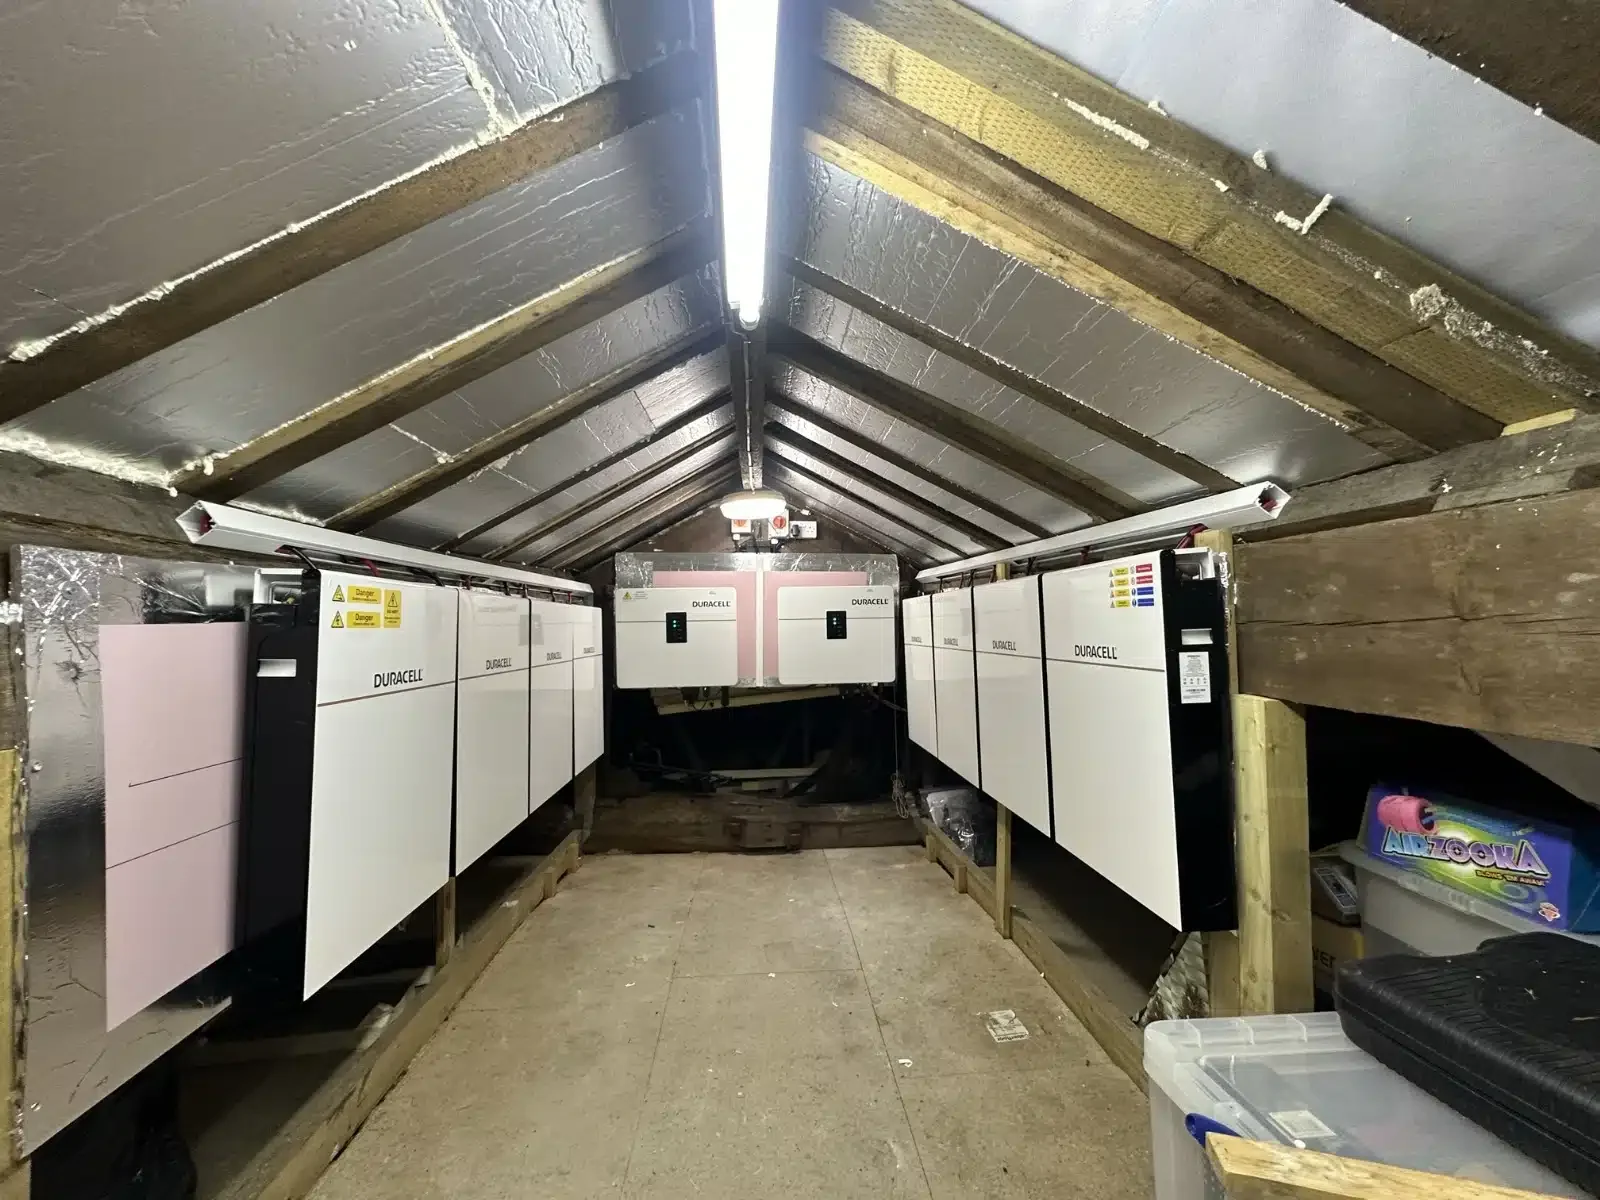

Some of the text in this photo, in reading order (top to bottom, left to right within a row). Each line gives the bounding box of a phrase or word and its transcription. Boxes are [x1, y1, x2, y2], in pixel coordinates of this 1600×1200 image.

[356, 589, 375, 598] Danger
[692, 600, 732, 608] DURACELL
[851, 598, 889, 606] DURACELL
[355, 613, 374, 622] Danger
[992, 640, 1017, 651] DURACELL
[1074, 644, 1118, 660] DURACELL
[485, 657, 512, 671] DURACELL
[373, 668, 424, 689] DURACELL
[1382, 824, 1551, 879] AIRZOOKA
